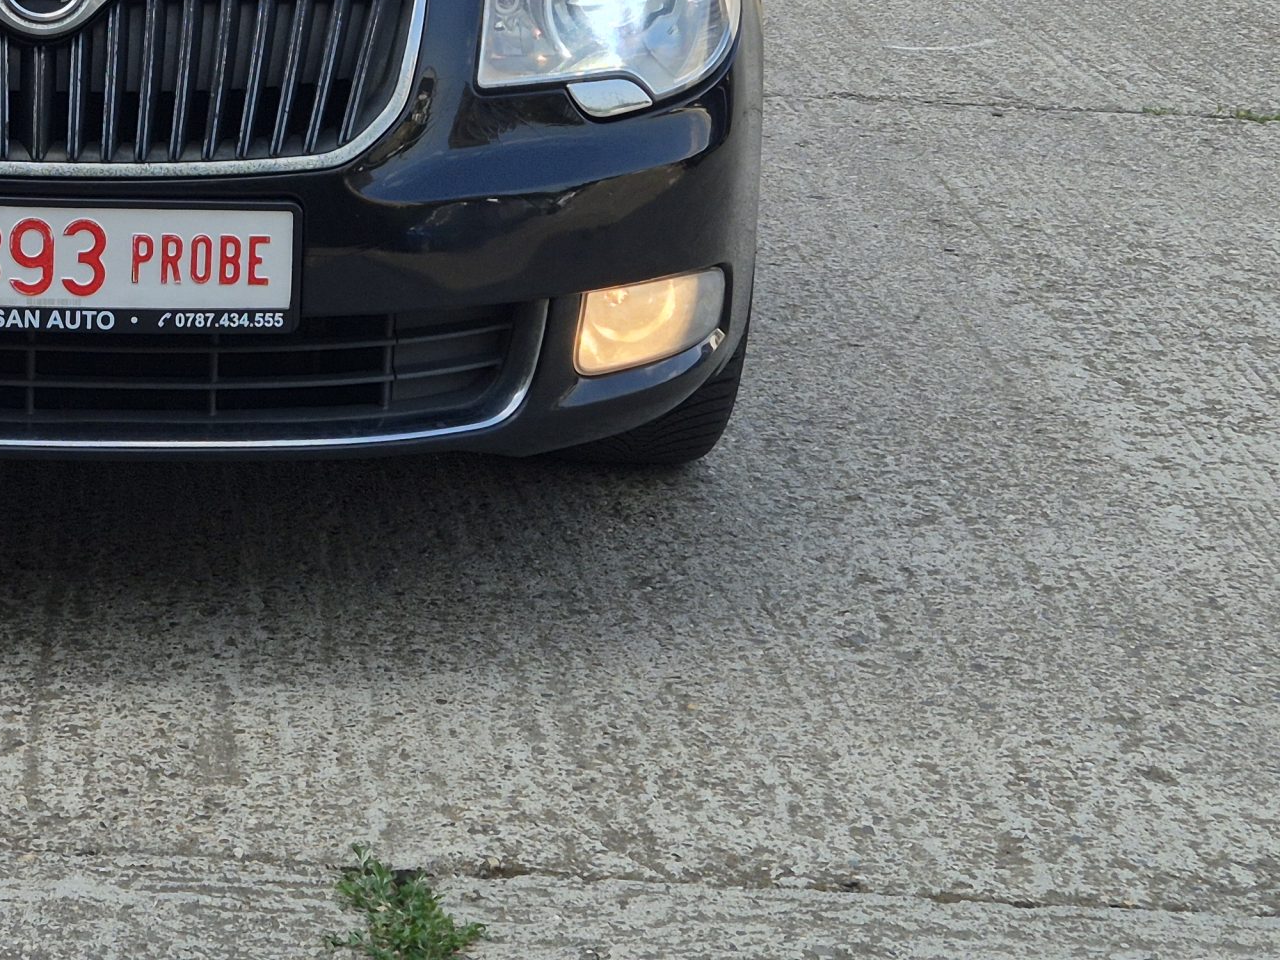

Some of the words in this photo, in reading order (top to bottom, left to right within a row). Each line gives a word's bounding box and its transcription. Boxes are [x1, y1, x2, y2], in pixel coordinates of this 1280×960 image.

[130, 233, 271, 287] PROBE
[46, 309, 116, 331] AUTO
[175, 312, 284, 328] 0787.434.555
